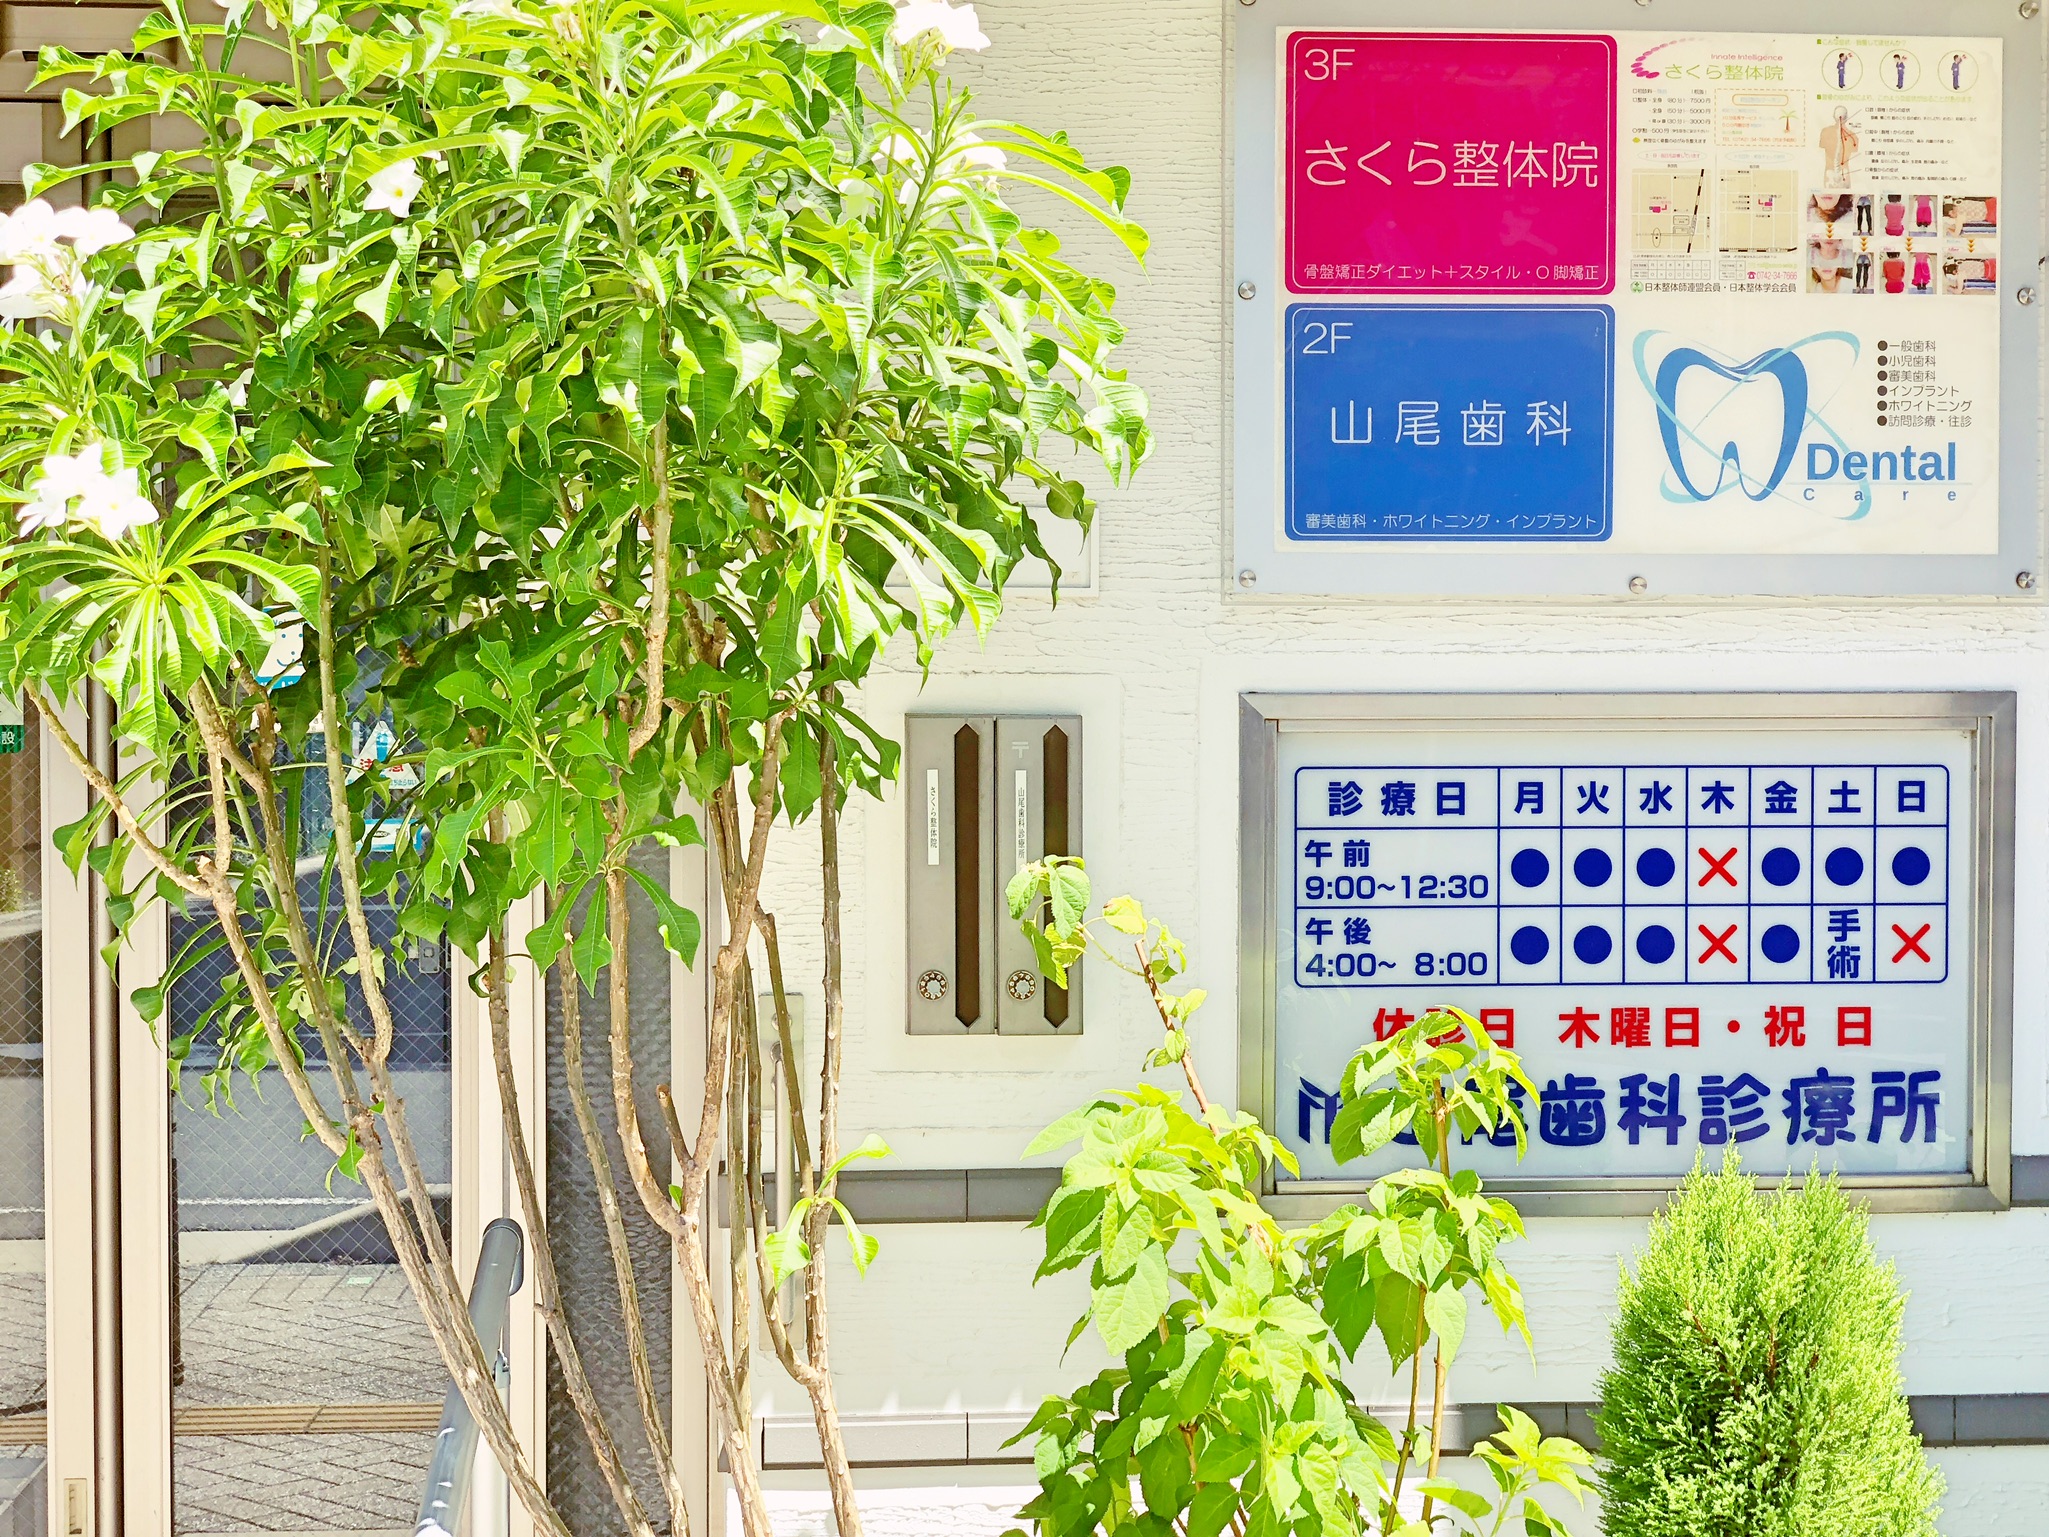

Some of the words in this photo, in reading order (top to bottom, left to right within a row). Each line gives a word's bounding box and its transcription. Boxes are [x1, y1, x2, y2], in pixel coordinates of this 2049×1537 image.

[1305, 49, 1355, 80] 3F
[1711, 53, 1736, 61] Innate
[1738, 53, 1783, 62] Intelligence
[1665, 63, 1784, 81] さくら整体院
[1306, 140, 1597, 187] さくら整体院
[1645, 282, 1797, 293] 日本整体師連盟会員・日本整体学会会員
[1303, 323, 1353, 354] 2F
[1889, 340, 1936, 352] 一般歯科
[1889, 355, 1936, 367] 小児歯科
[1889, 370, 1936, 382] 審美歯科
[1889, 385, 1959, 397] インプラント
[1889, 400, 1972, 412] ホワイトニング
[1332, 400, 1571, 446] 山尾歯科
[1888, 415, 1972, 428] 訪問診療・往診
[1807, 442, 1956, 481] Dental
[1803, 488, 1957, 501] Care
[1306, 513, 1596, 529] 審美歯科・ホワイトニング・インプラント
[1328, 781, 1465, 816] 診療日
[1514, 782, 1543, 814] 月
[1578, 781, 1609, 814] 火
[1640, 781, 1672, 814] 水
[1702, 781, 1734, 813] 木
[1765, 781, 1797, 813] 金
[1828, 781, 1861, 813] 土
[1898, 781, 1925, 812] 日
[1305, 839, 1370, 867] 午前
[1306, 875, 1488, 899] 9:00~12:30
[1306, 917, 1371, 945] 午後
[1828, 909, 1861, 978] 手術
[1415, 952, 1487, 976] 8:00
[1560, 1007, 1871, 1048] 木曜日・祝日
